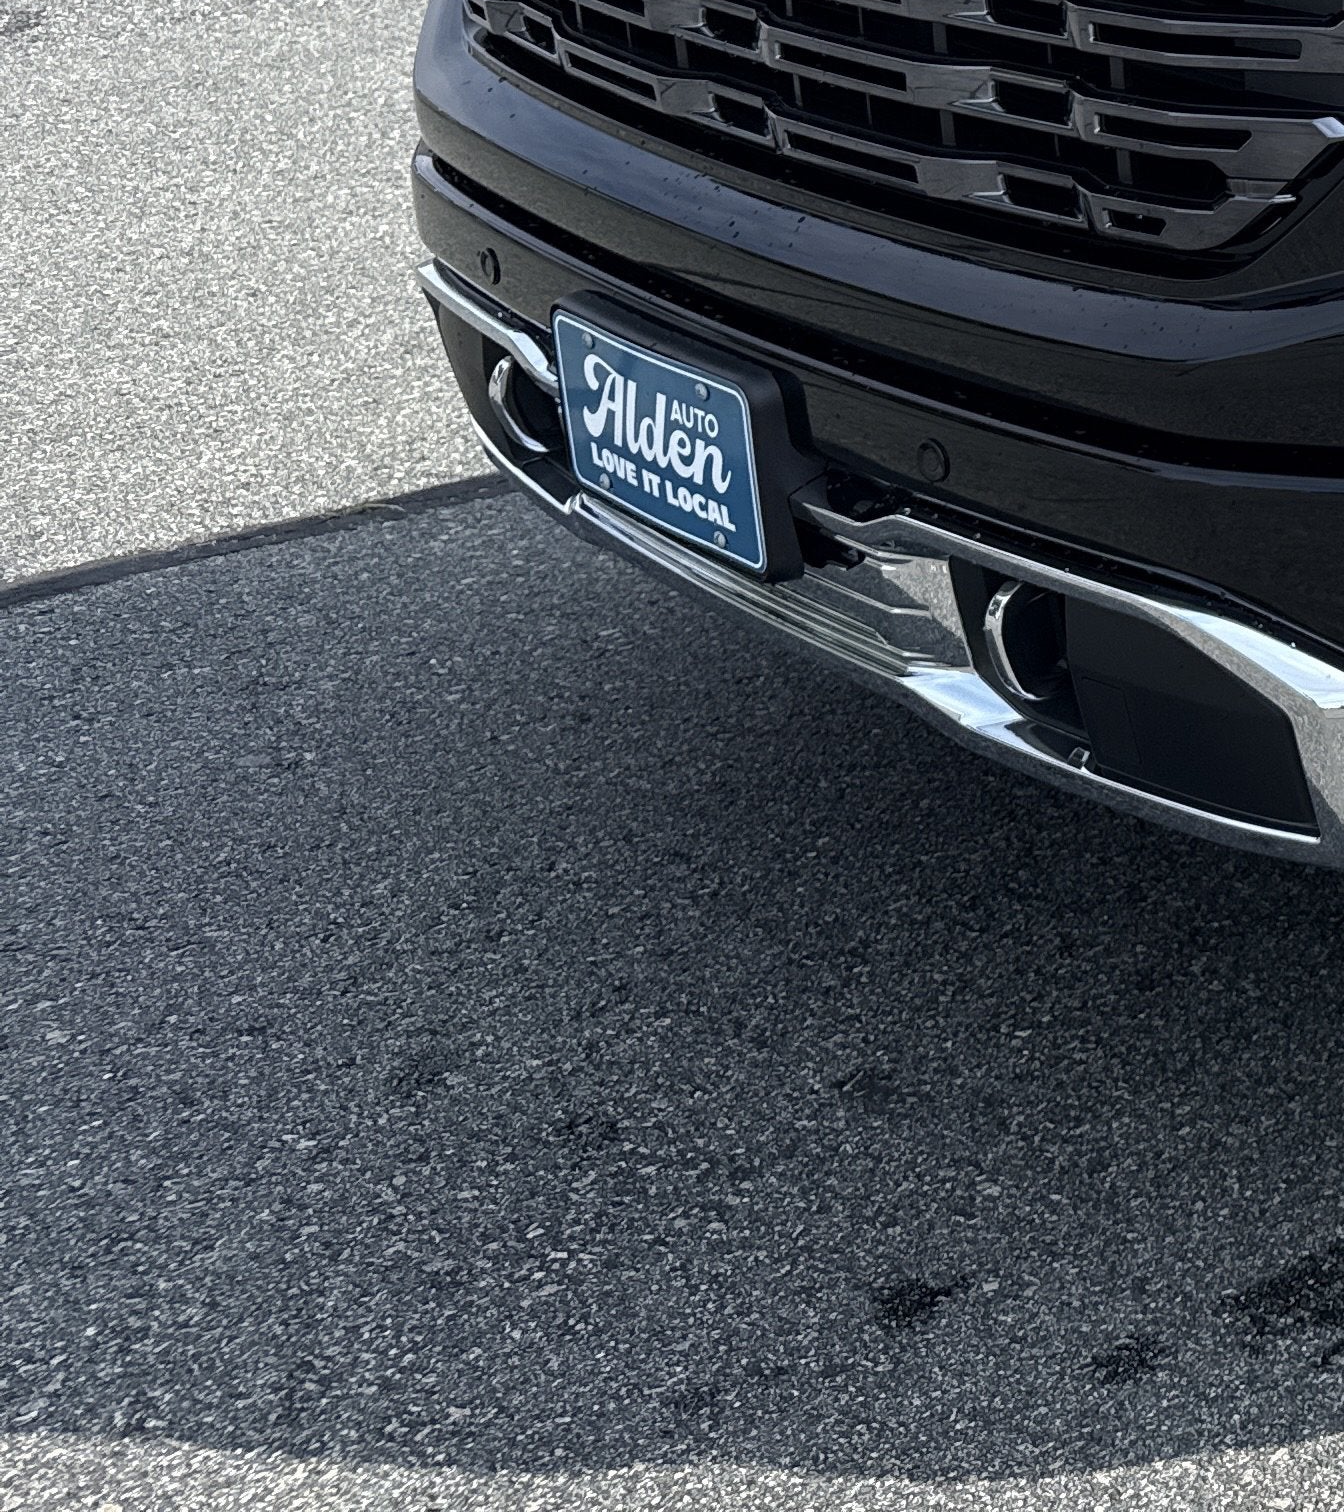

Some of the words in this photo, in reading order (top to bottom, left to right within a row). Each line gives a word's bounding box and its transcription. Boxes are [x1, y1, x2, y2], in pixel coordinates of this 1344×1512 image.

[583, 354, 732, 494] Alden
[670, 399, 719, 438] AUTO
[590, 442, 639, 487] LOVE
[641, 468, 661, 498] IT
[665, 480, 737, 533] LOCAL
